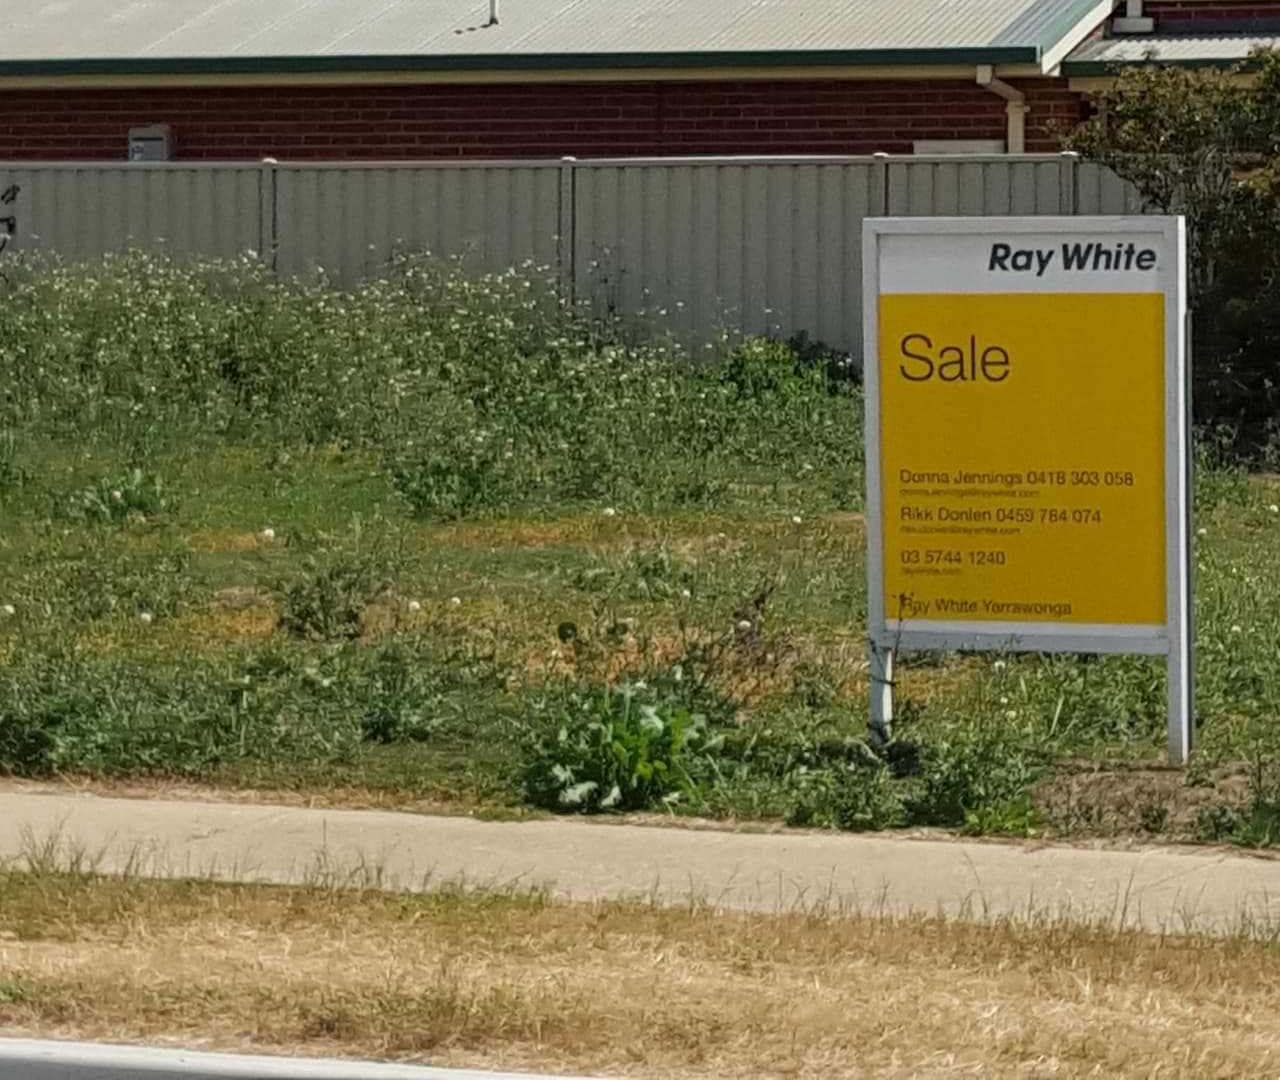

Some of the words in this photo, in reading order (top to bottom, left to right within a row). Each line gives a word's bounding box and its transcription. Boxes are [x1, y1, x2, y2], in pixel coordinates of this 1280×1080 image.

[989, 243, 1054, 277] Ray
[1062, 242, 1157, 271] White
[900, 333, 1010, 382] Sale
[900, 470, 949, 484] Donna
[954, 470, 1022, 488] Jennings
[1027, 471, 1066, 486] 0418
[1071, 472, 1099, 486] 303
[1105, 472, 1134, 487] 058
[901, 507, 933, 522] Rikk
[996, 508, 1034, 523] 0459
[1040, 509, 1067, 523] 784
[1072, 510, 1101, 524] 074
[901, 550, 920, 564] 03
[924, 550, 962, 565] 5744
[969, 551, 1006, 566] 1240
[902, 596, 930, 614] Ray
[935, 598, 978, 613] White
[984, 600, 1072, 617] Yarrawonga
